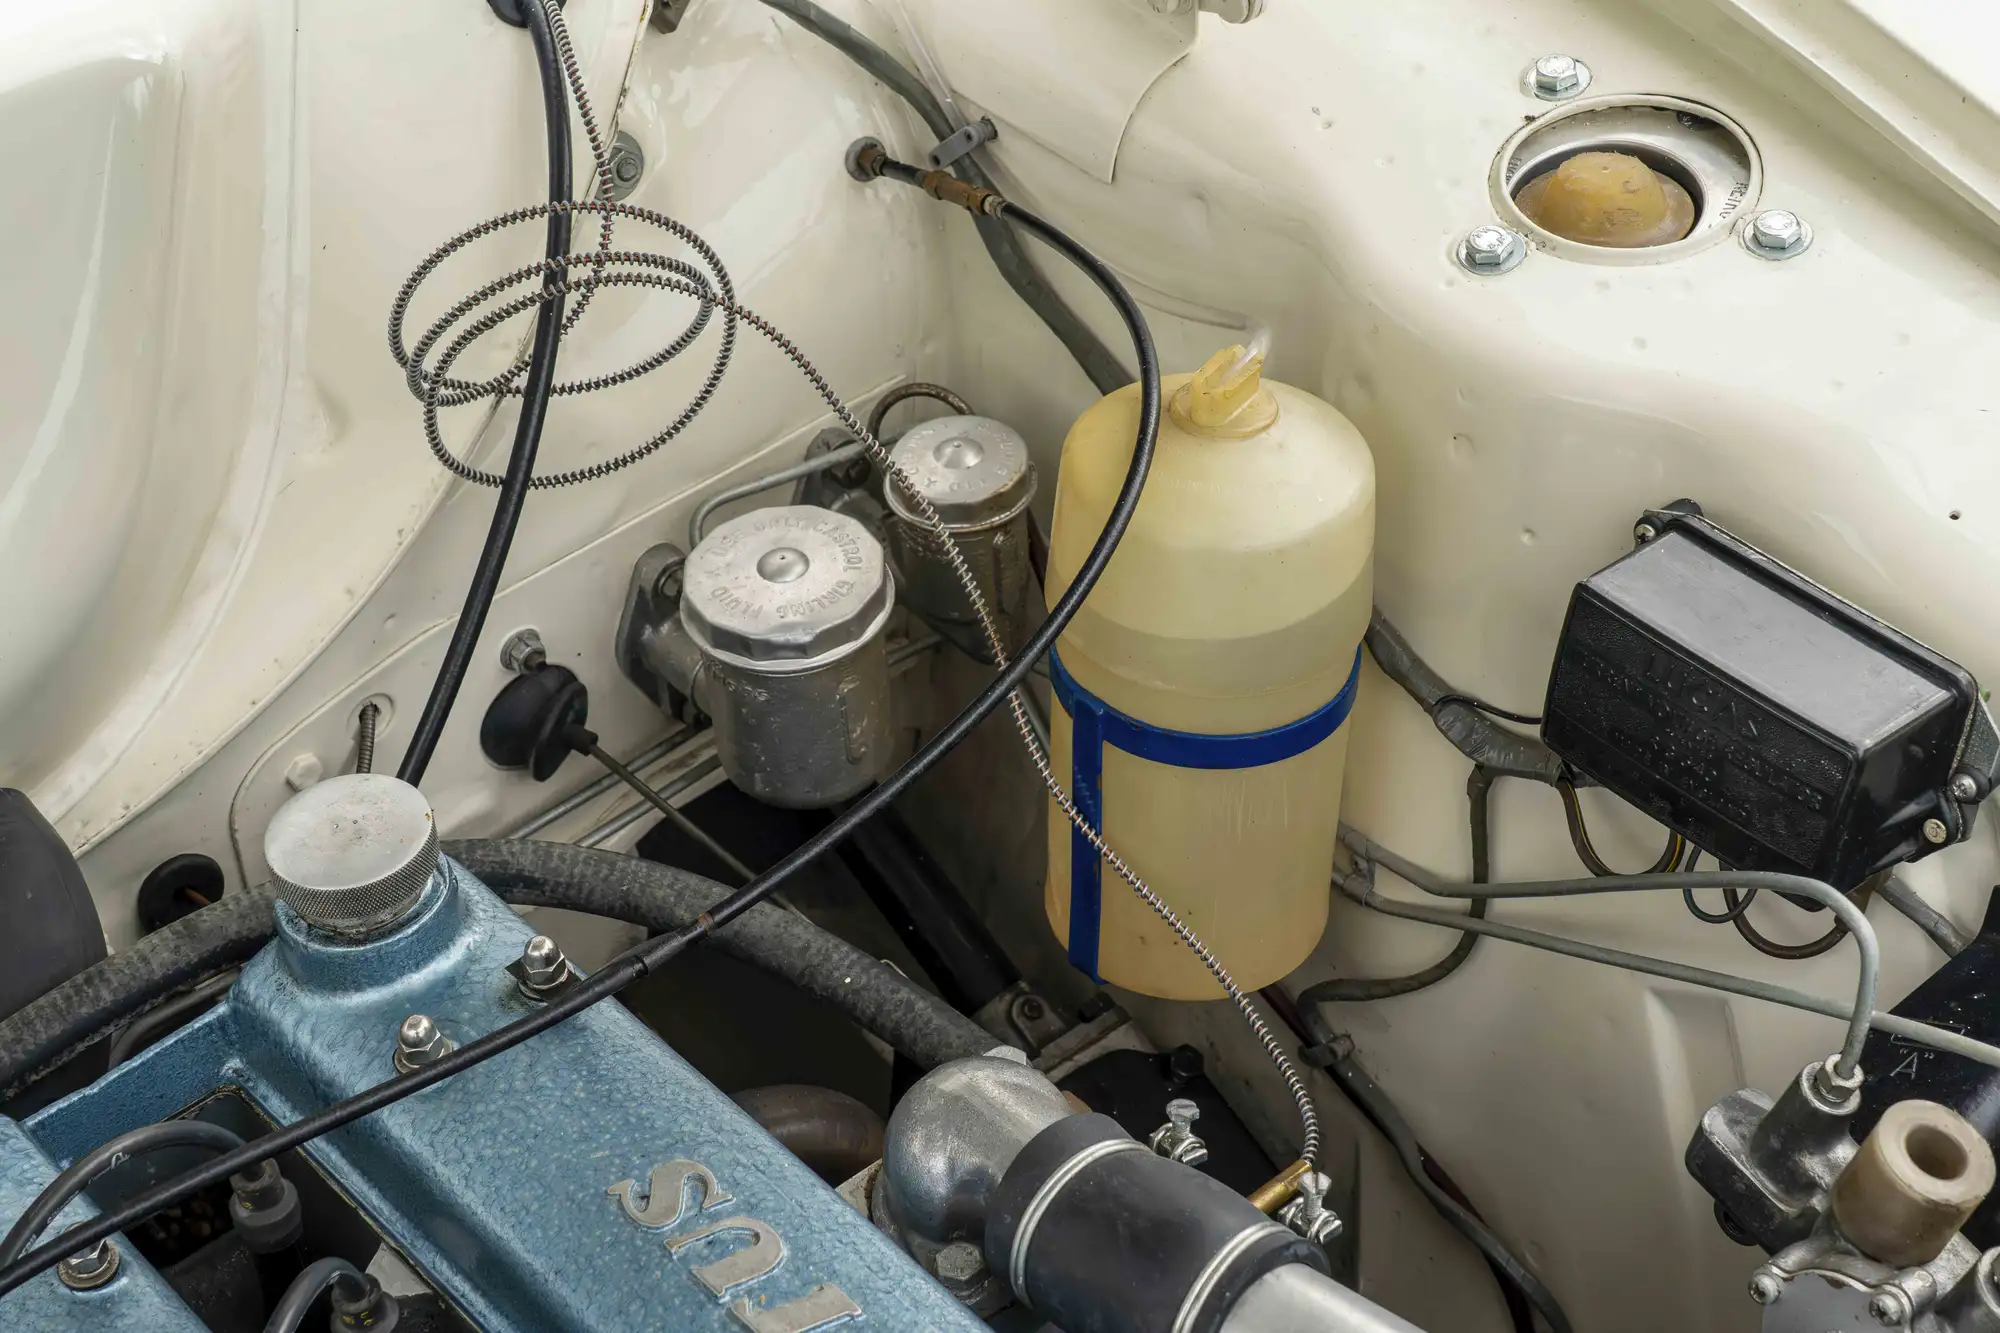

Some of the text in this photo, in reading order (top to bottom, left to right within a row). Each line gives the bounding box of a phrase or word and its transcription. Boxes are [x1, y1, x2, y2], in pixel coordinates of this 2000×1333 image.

[813, 520, 863, 573] CASTROL
[711, 586, 763, 618] FLUID
[777, 580, 856, 619] GIRLING
